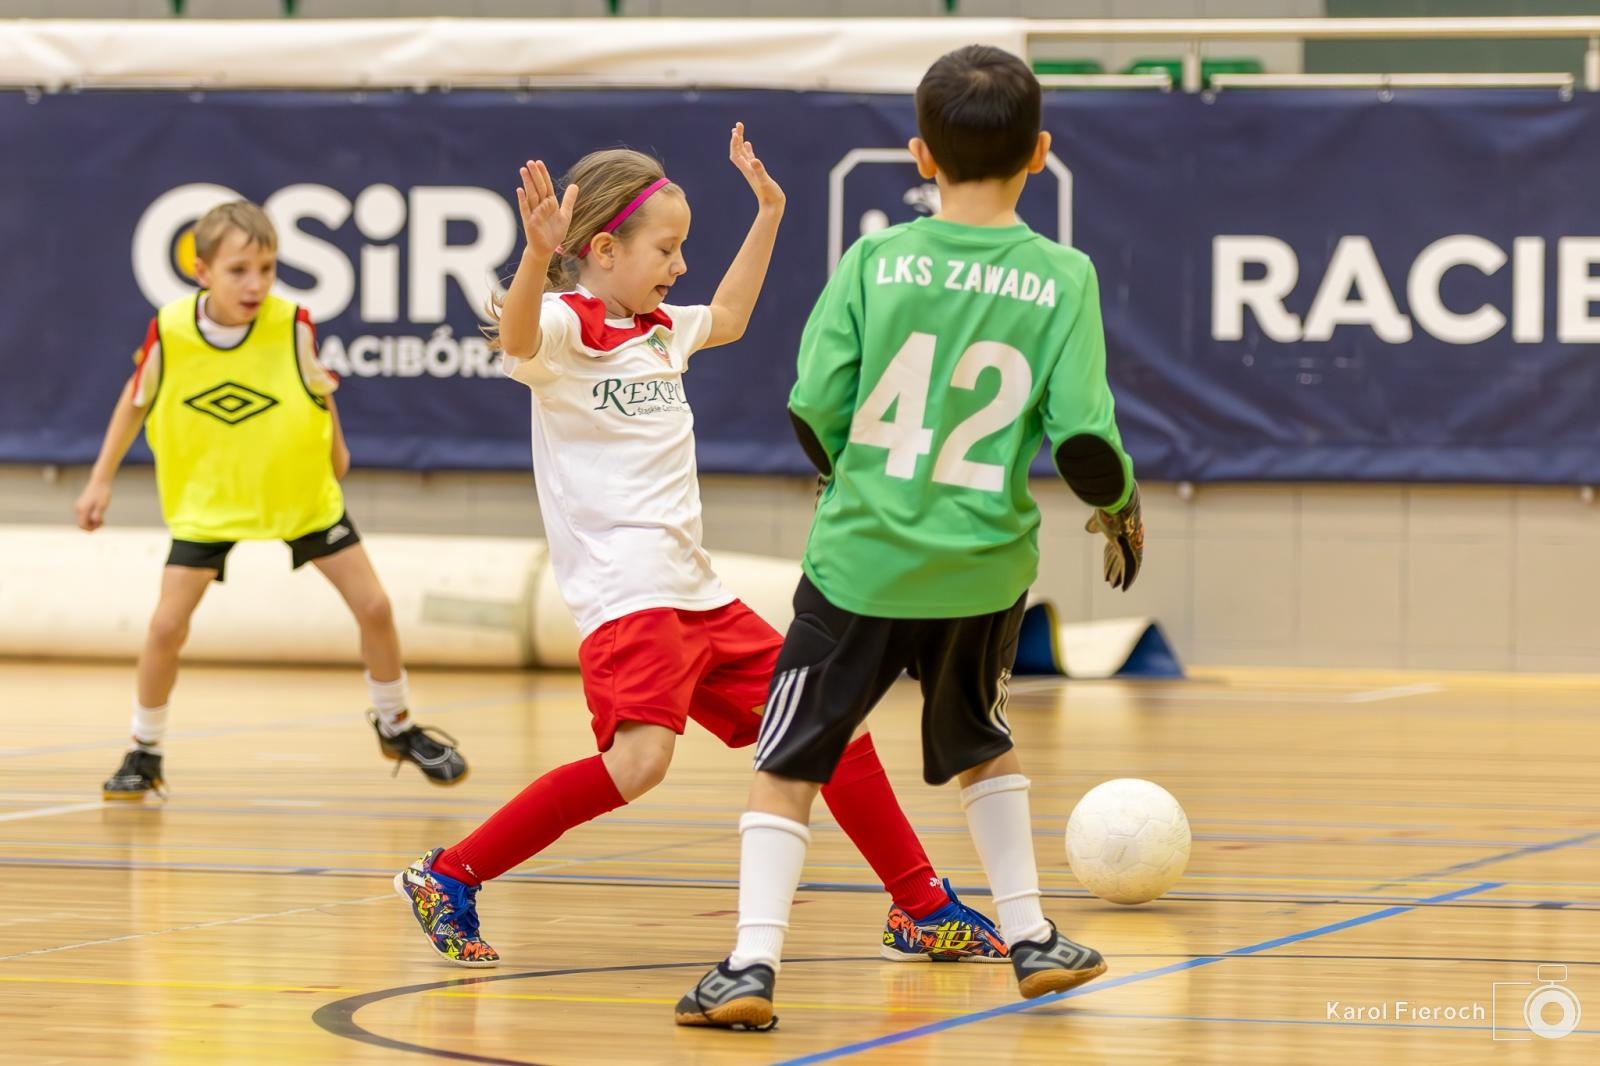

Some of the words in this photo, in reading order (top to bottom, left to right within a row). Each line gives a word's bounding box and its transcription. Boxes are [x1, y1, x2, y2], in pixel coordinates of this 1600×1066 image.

[875, 254, 935, 286] LKS
[944, 260, 1056, 308] ZAWADA
[849, 331, 1033, 493] 42
